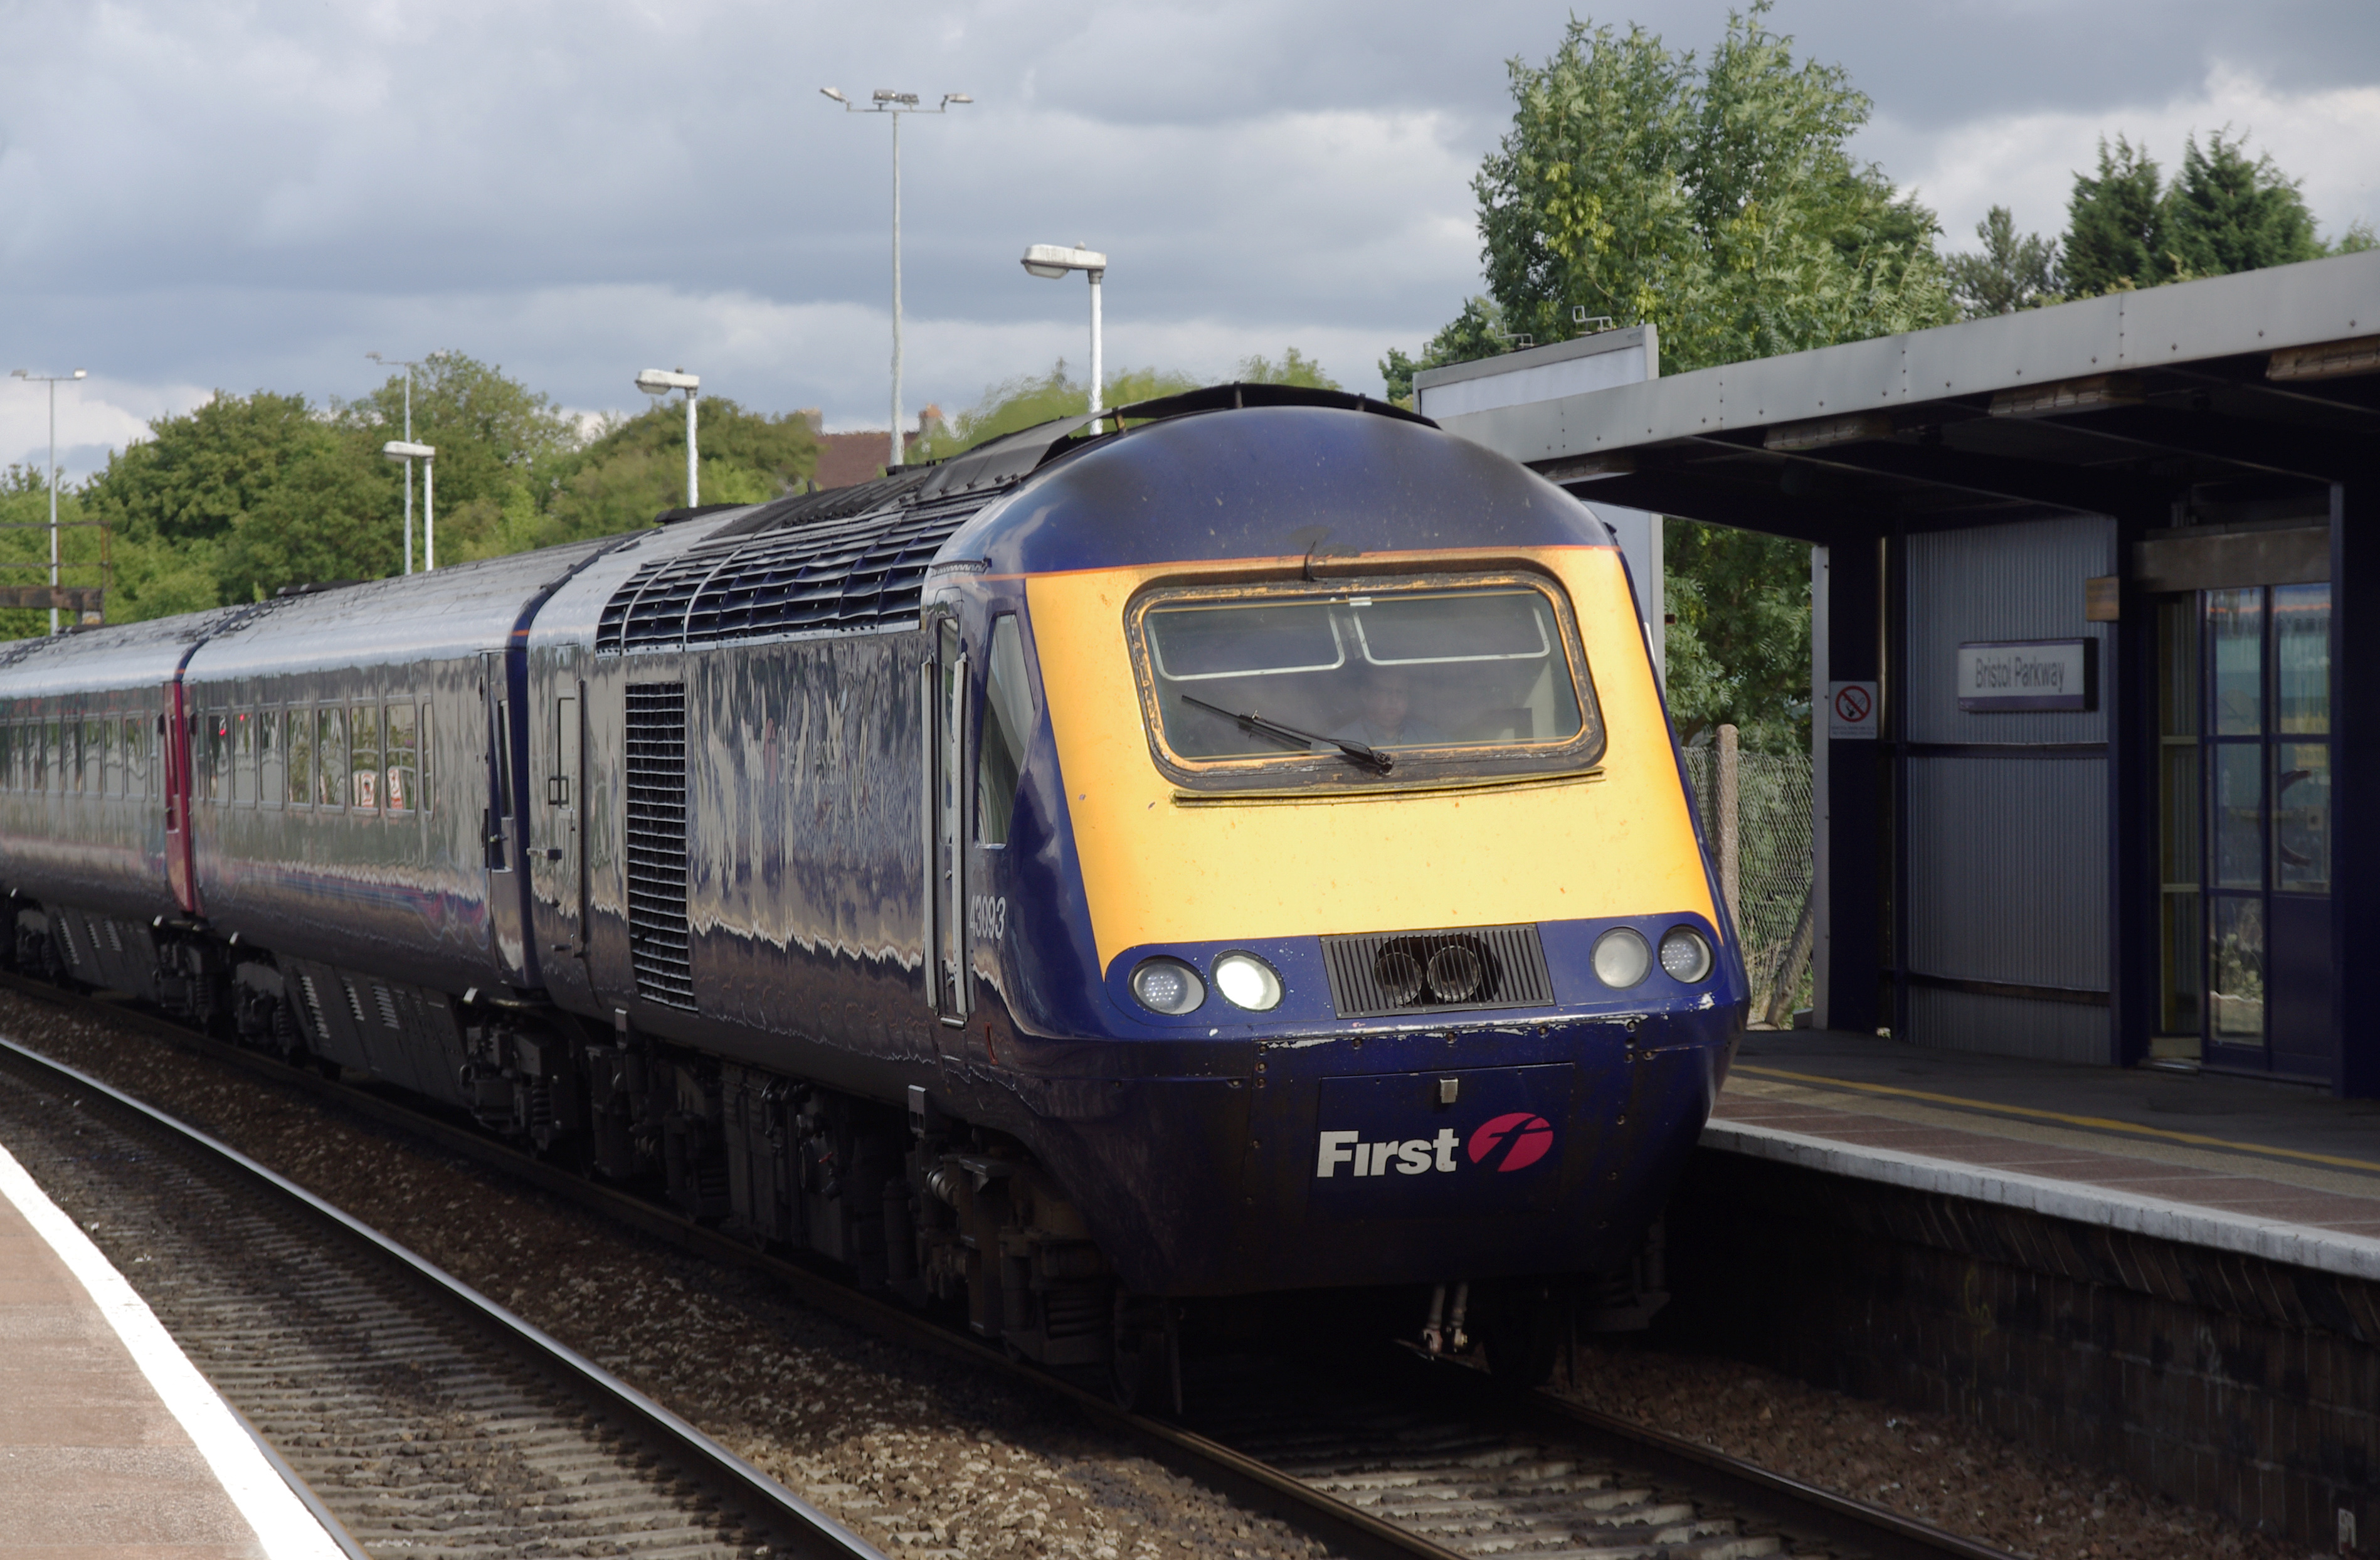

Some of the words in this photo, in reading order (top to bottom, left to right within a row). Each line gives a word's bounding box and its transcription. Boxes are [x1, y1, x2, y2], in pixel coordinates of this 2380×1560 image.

[1976, 657, 2011, 689] Bristol
[2014, 656, 2065, 693] Parkway
[969, 894, 1006, 940] 43093
[1317, 1128, 1460, 1178] First
